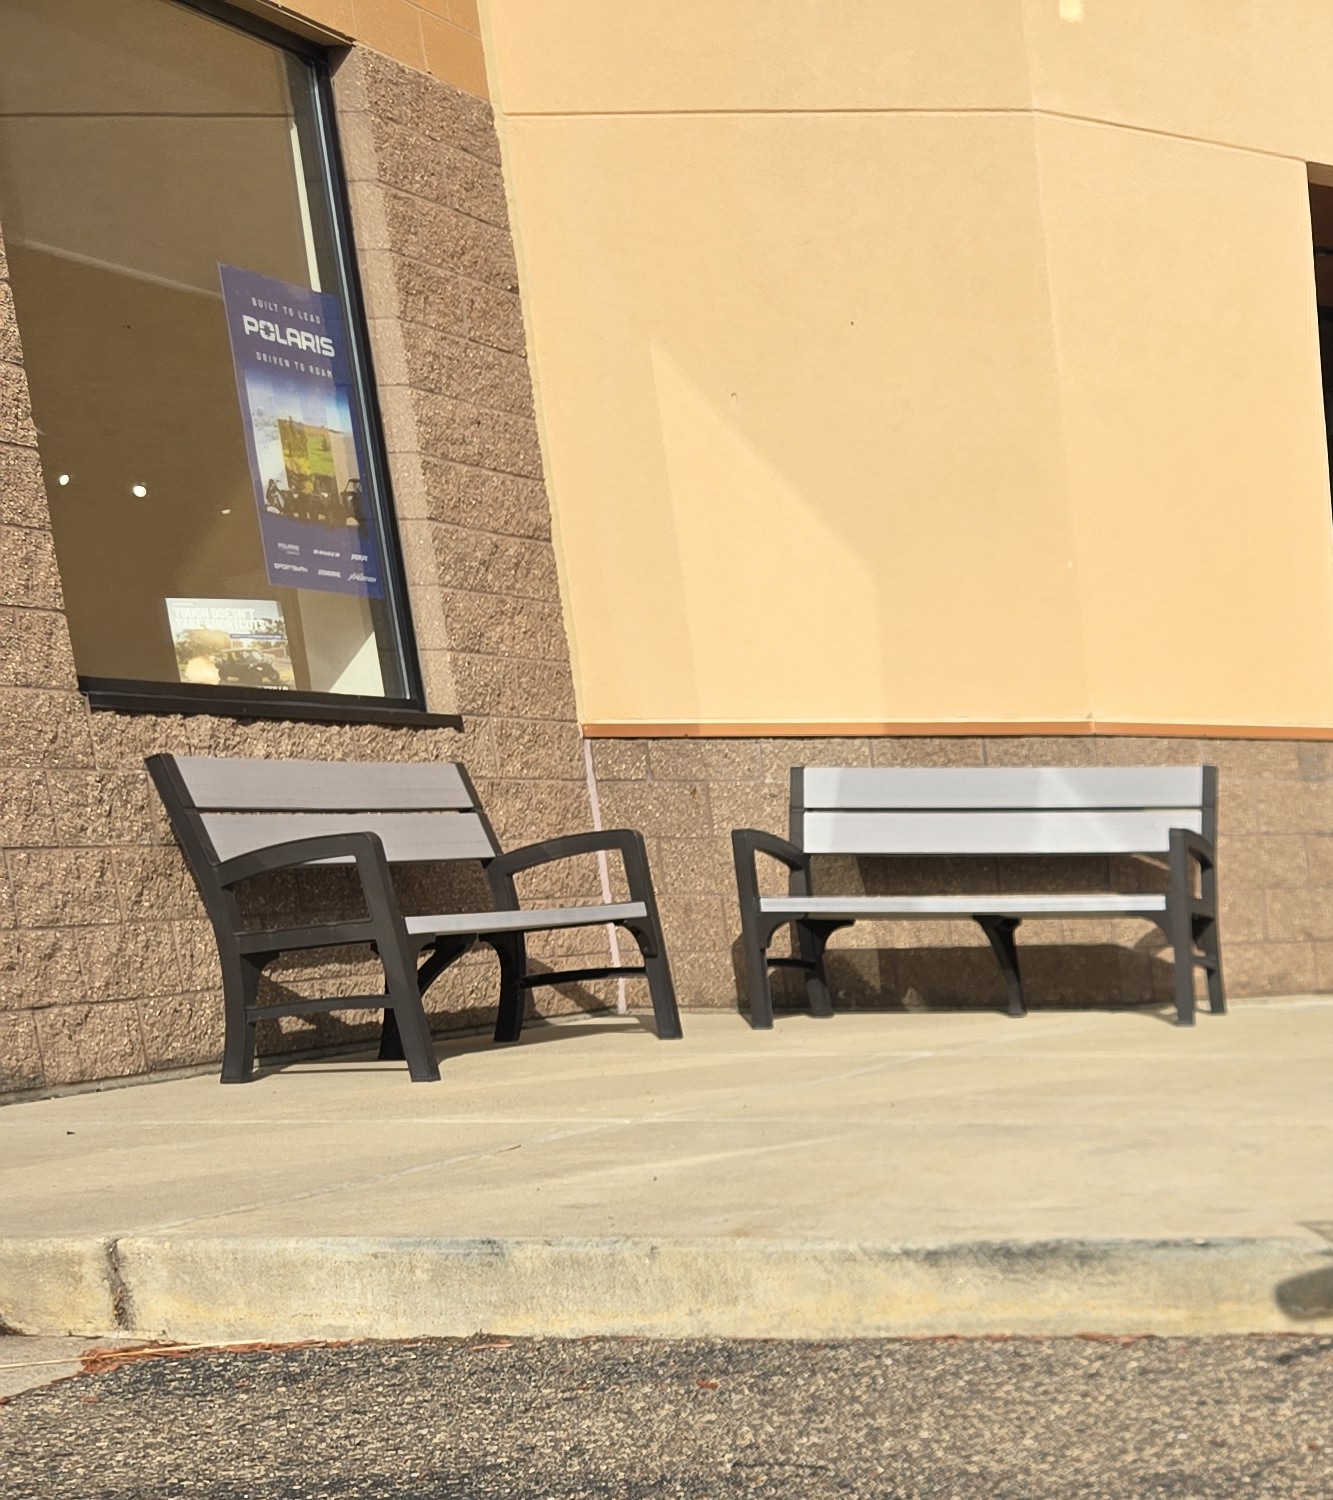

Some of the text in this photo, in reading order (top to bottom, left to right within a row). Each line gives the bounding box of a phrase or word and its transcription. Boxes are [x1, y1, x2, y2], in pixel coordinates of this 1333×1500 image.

[251, 296, 321, 325] BUILT TO LEAD
[242, 314, 335, 358] POLARIS
[255, 351, 333, 379] DRIVEN TO ROAM
[173, 607, 255, 620] TOUGH DOESN'T
